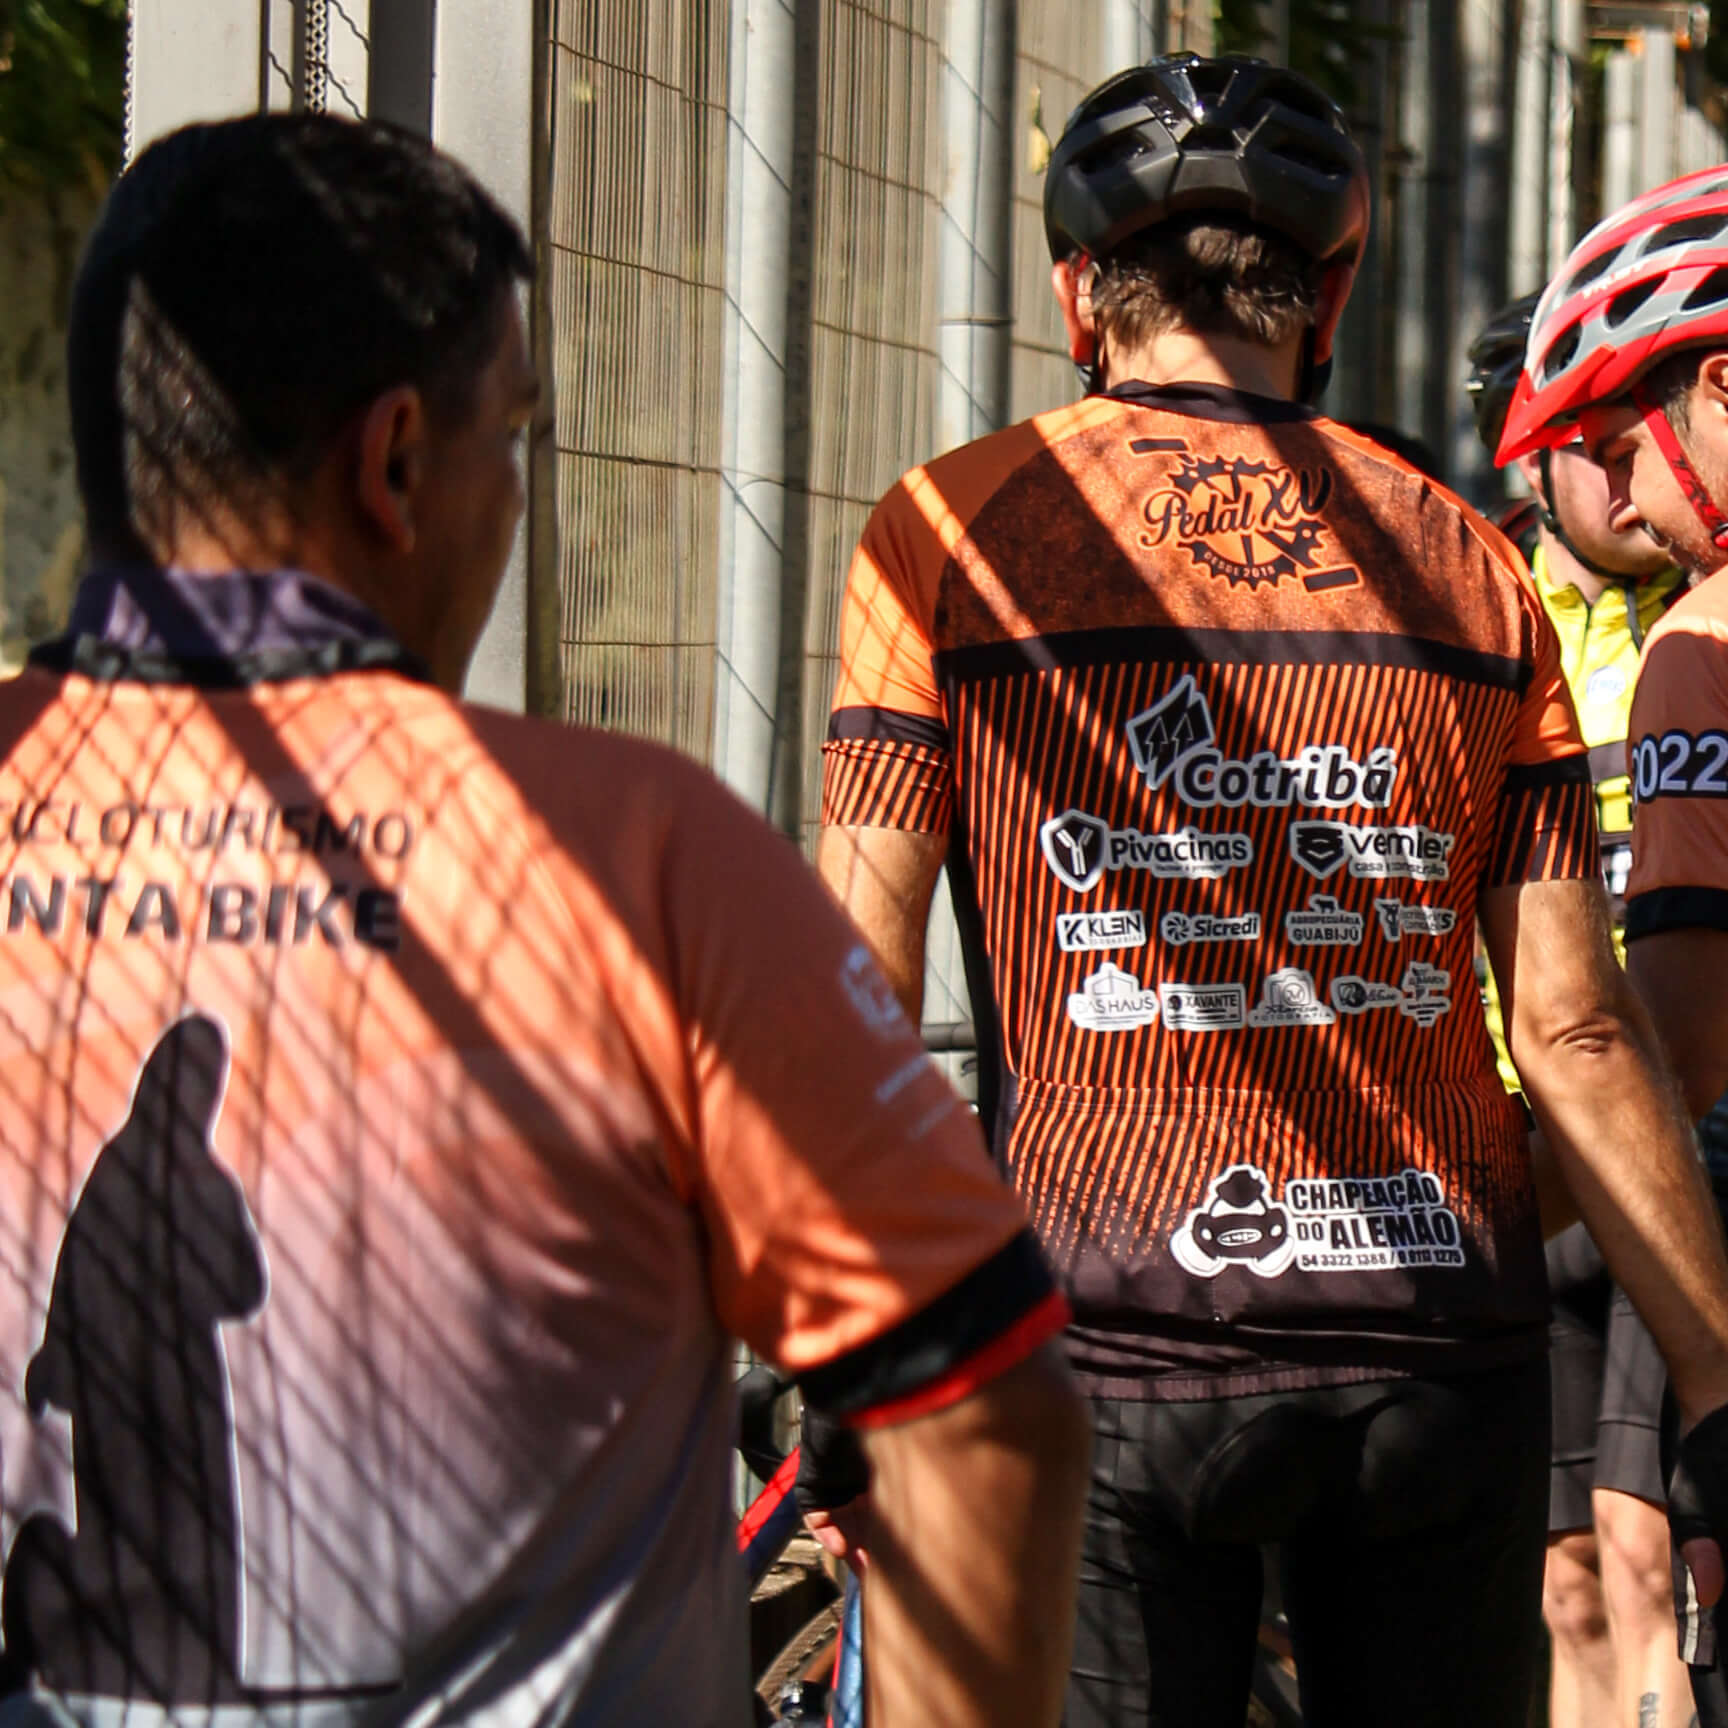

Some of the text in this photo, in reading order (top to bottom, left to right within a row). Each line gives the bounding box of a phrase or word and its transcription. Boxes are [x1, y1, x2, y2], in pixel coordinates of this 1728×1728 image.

[1141, 490, 1255, 546] Pedal
[1181, 753, 1392, 802] Cotribá
[0, 800, 412, 860] ICLOTURISMO
[1109, 833, 1248, 864] Pivacinas
[205, 881, 400, 952] BIKE
[1193, 916, 1259, 937] Sicredi
[1107, 995, 1155, 1014] HAUS
[1184, 993, 1238, 1008] XAVANTE
[1290, 1172, 1440, 1210] CHAPEAÇÃO
[1296, 1221, 1325, 1241] DO
[1329, 1208, 1457, 1249] ALEMÃO
[1301, 1254, 1318, 1267] 54
